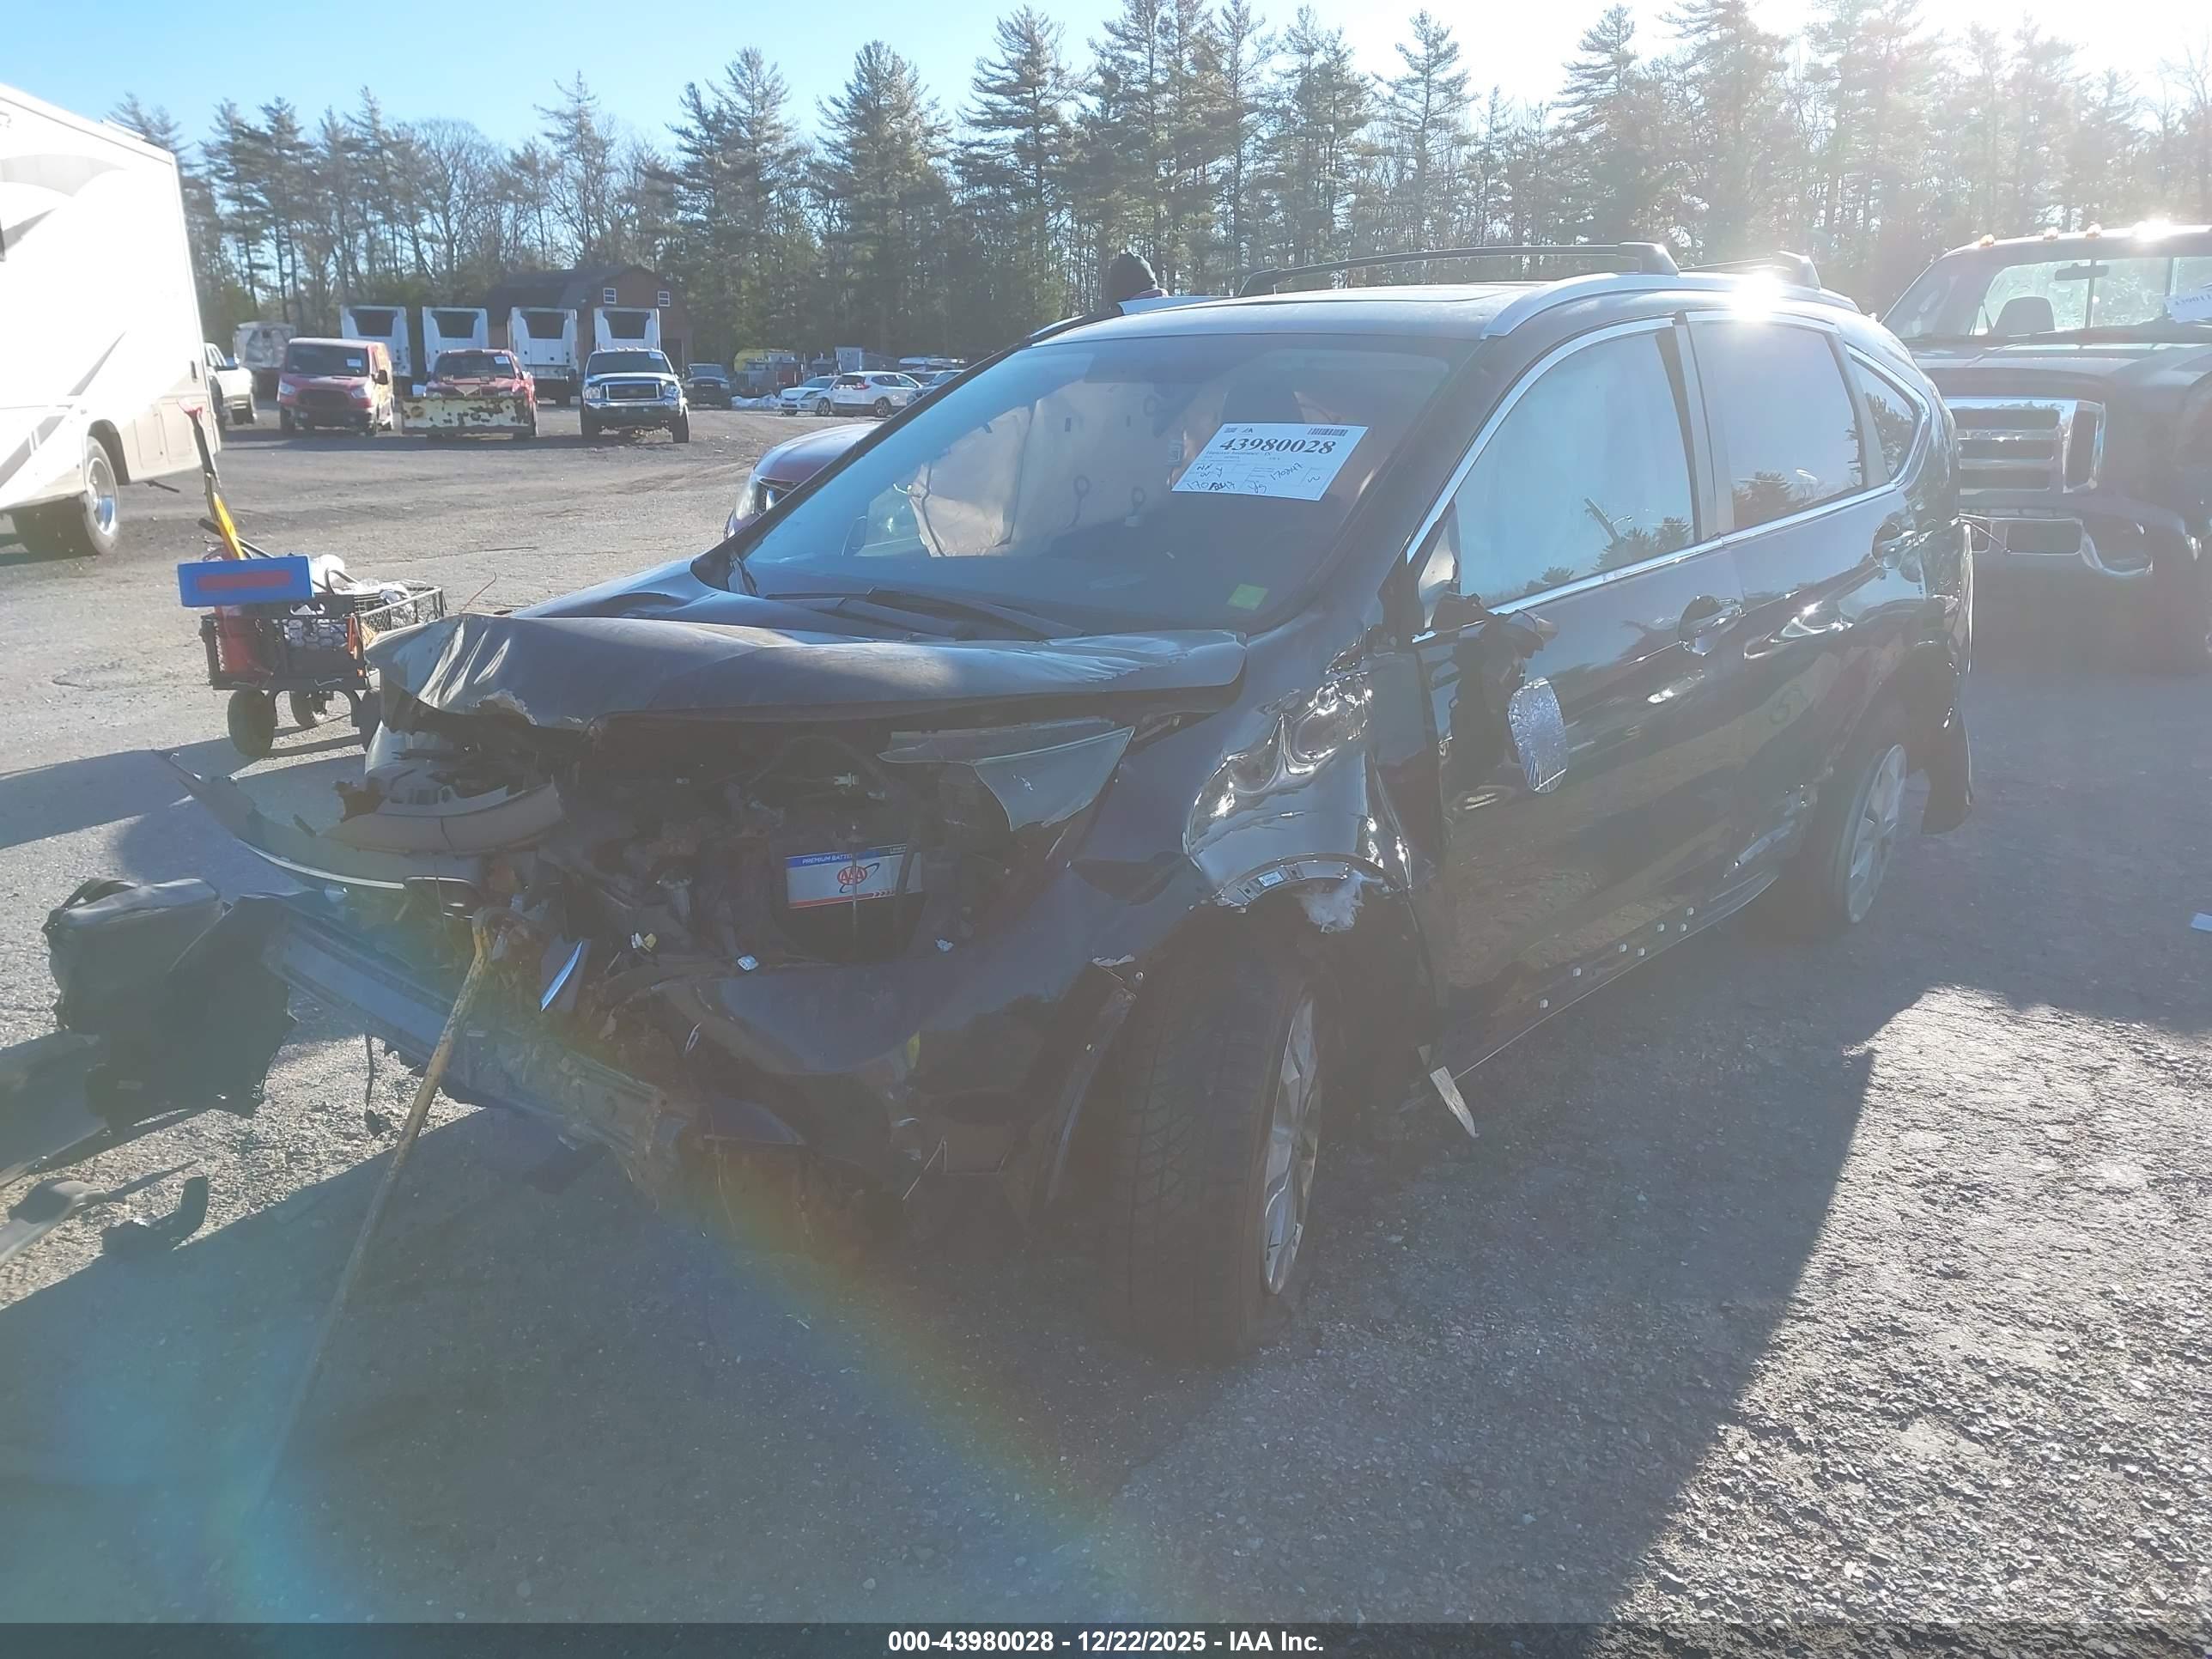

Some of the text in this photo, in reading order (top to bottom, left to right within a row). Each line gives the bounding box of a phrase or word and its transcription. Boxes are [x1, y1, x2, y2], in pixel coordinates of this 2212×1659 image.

[1219, 437, 1336, 455] 43980028
[802, 854, 831, 865] PREMIUM
[839, 868, 866, 883] AAA
